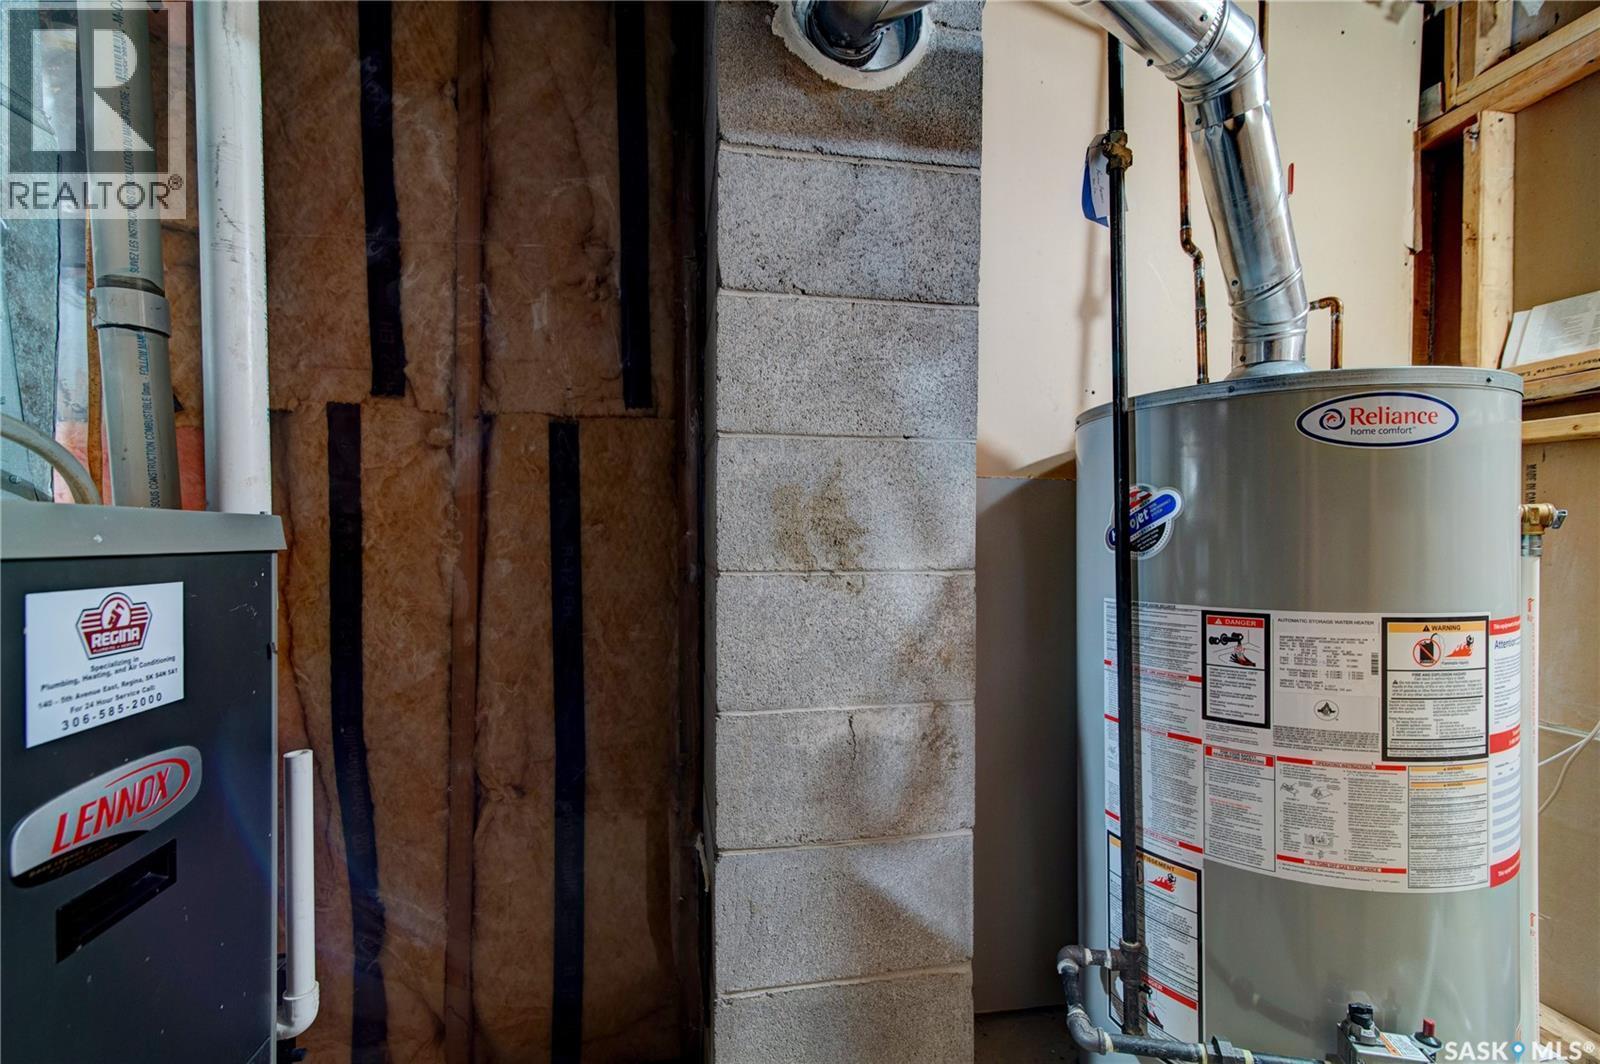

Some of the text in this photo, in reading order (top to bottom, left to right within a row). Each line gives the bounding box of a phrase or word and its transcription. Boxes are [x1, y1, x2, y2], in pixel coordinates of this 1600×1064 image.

[1349, 406, 1439, 426] Reliance
[1350, 427, 1376, 435] home
[1225, 619, 1257, 627] DANGER
[91, 628, 140, 648] REGINA
[90, 658, 132, 672] Specializing
[139, 655, 176, 669] Conditioning
[61, 692, 163, 731] 306-585-2000
[51, 766, 171, 855] LENNOX
